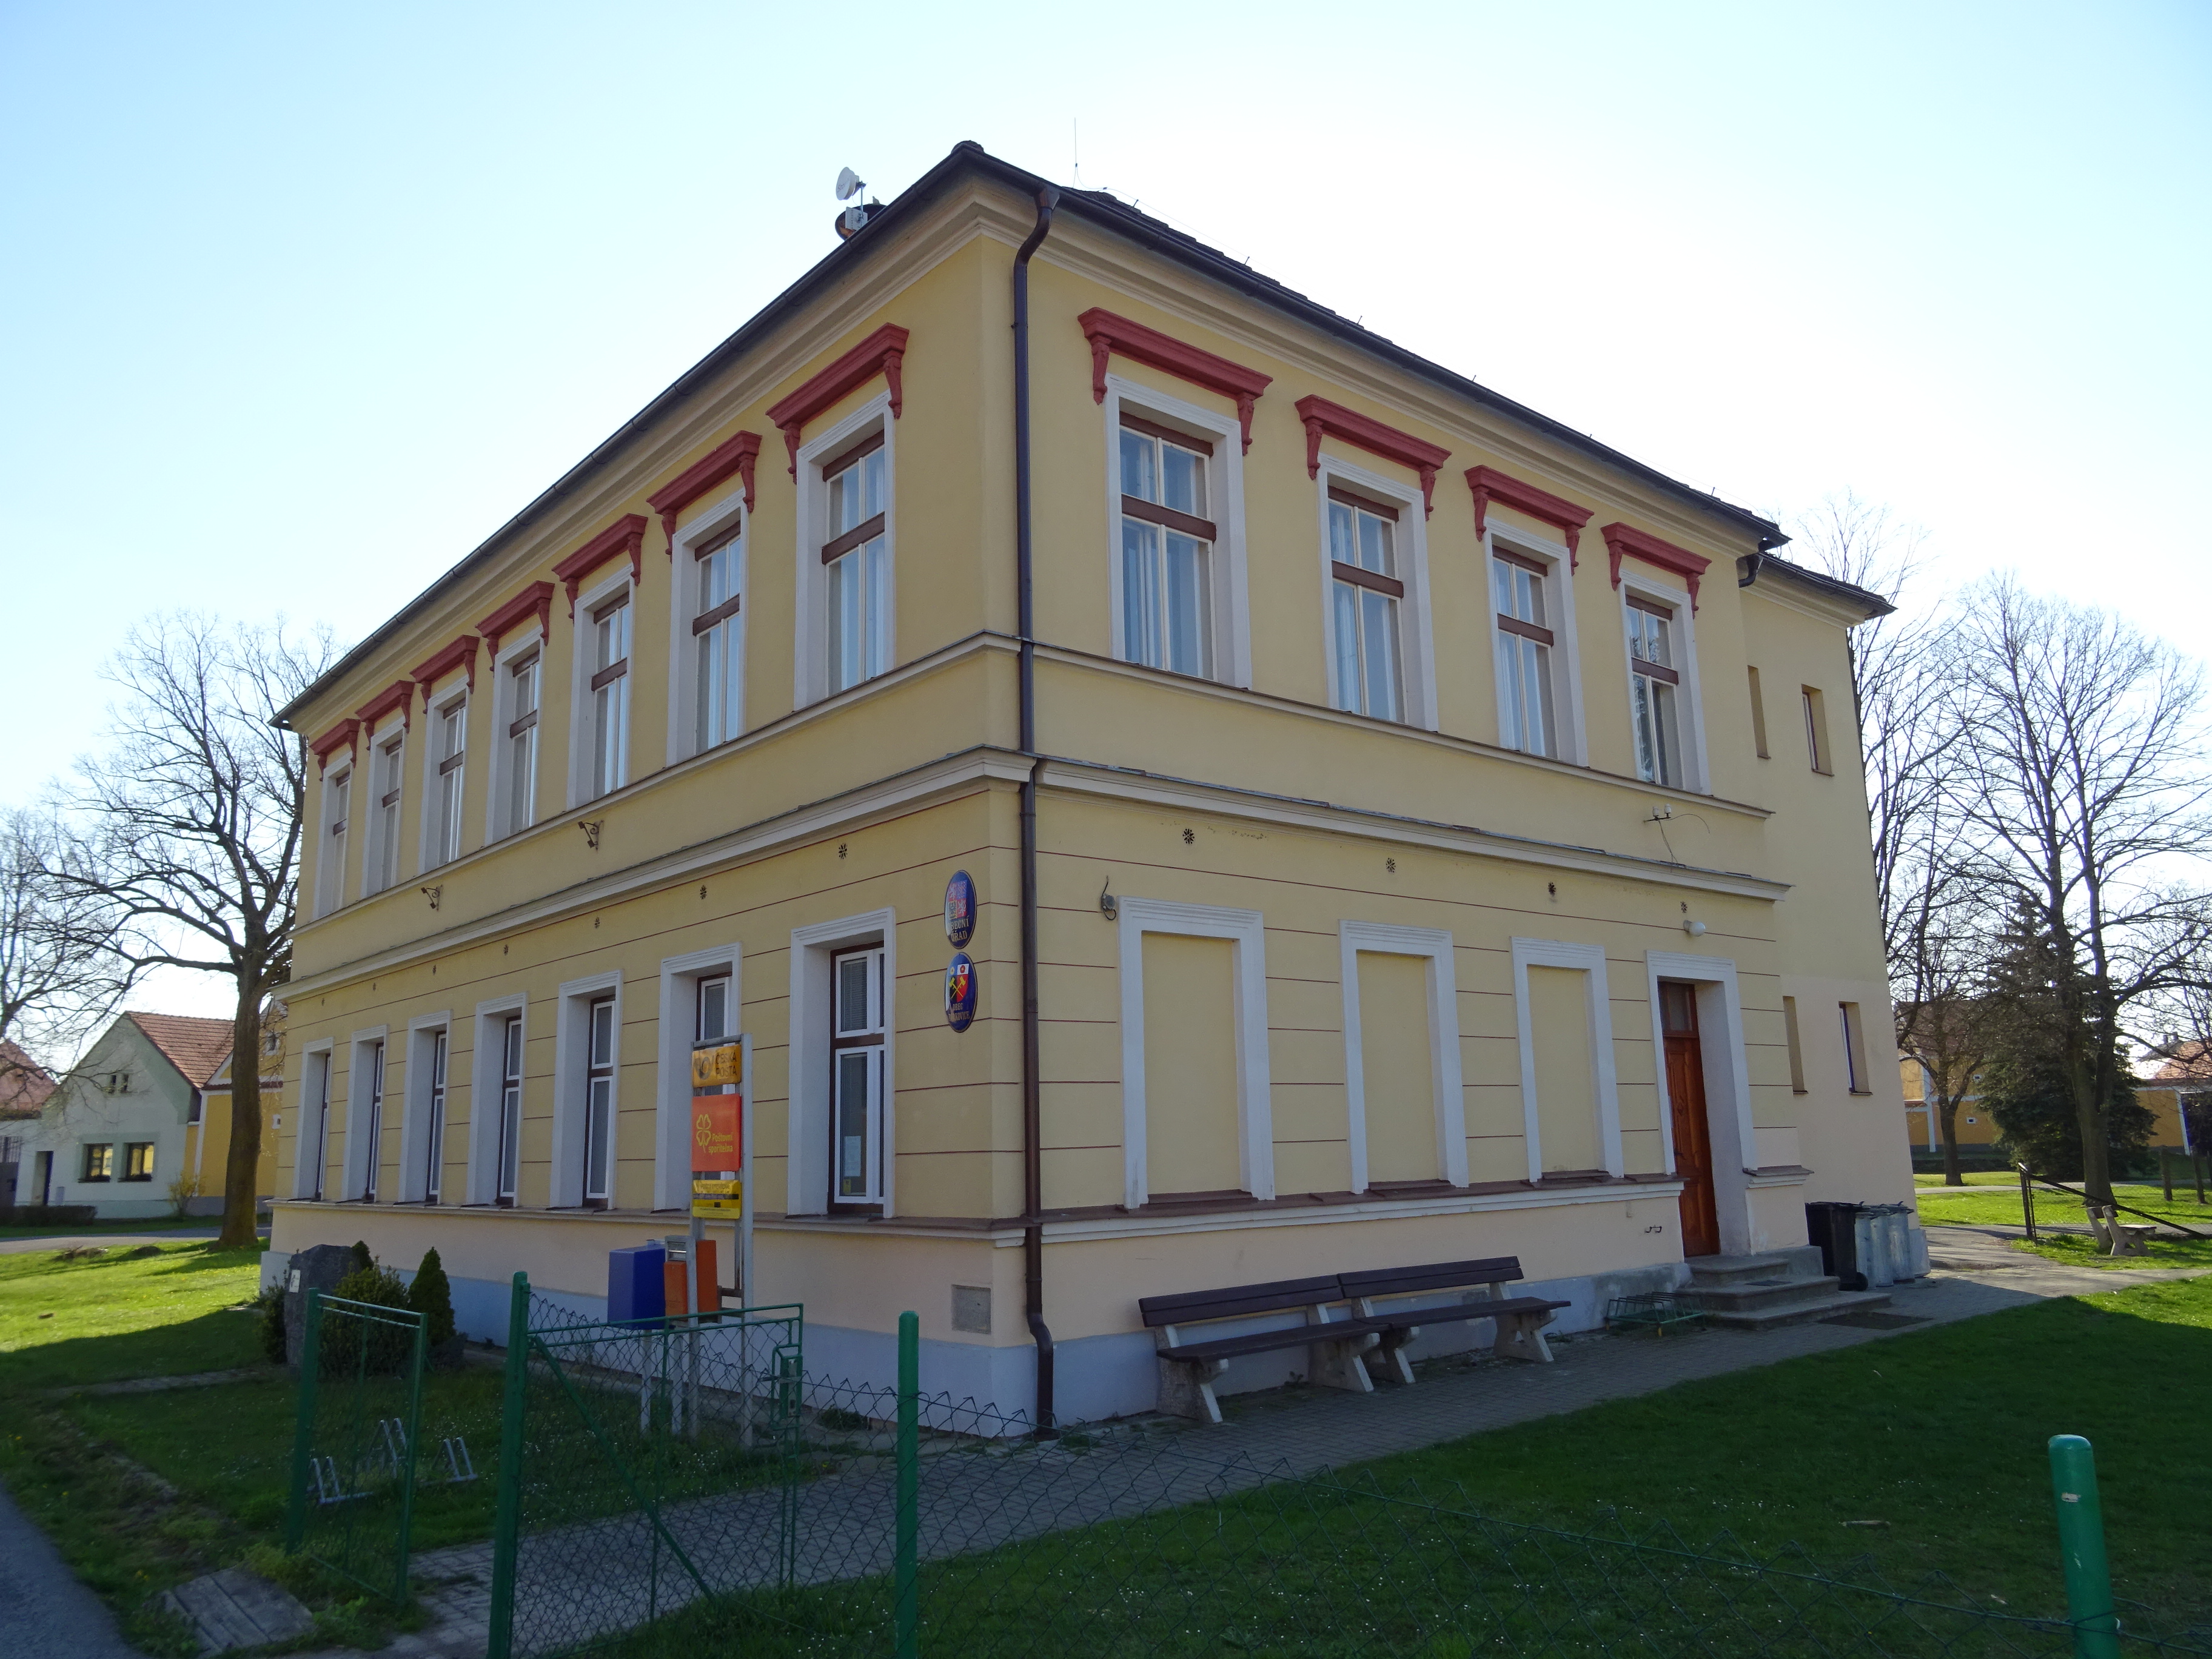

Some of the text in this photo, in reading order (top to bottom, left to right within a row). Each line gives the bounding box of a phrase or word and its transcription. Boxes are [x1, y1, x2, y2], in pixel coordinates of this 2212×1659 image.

[947, 915, 970, 931] BECNÍ
[953, 1002, 964, 1011] OBEC
[716, 1065, 737, 1078] POŠTA
